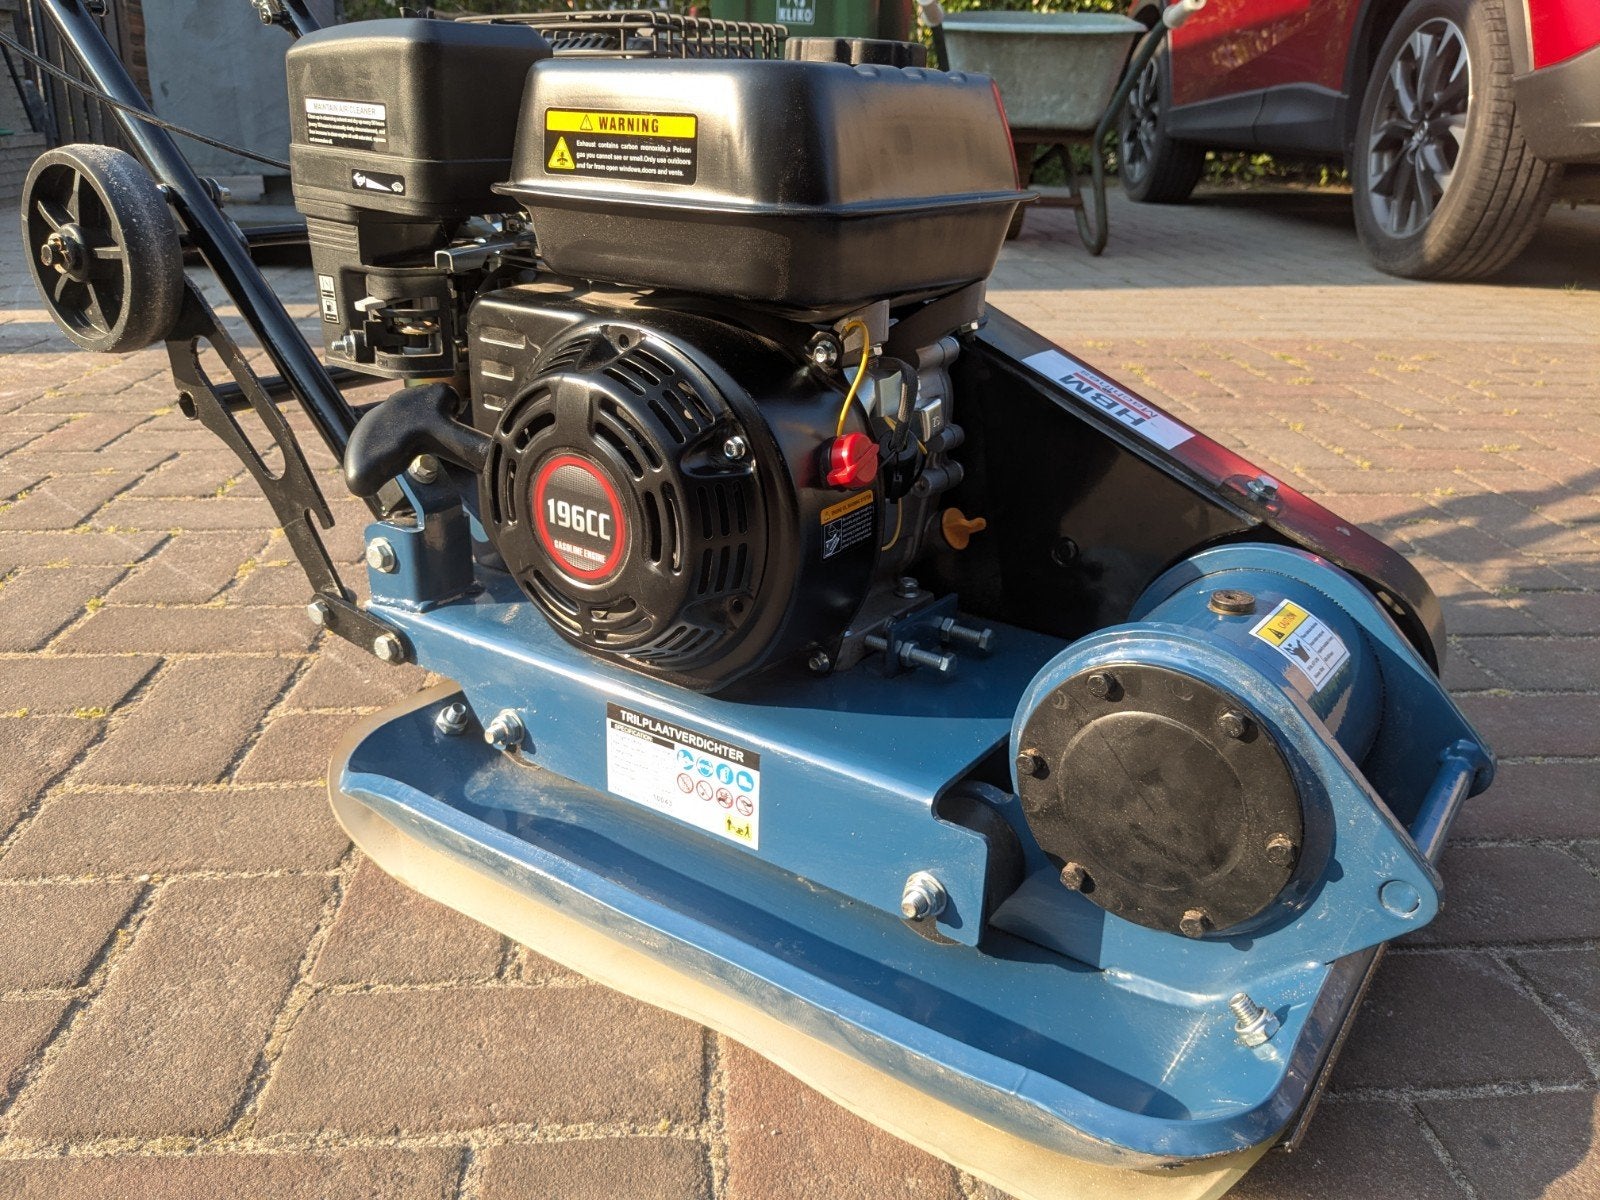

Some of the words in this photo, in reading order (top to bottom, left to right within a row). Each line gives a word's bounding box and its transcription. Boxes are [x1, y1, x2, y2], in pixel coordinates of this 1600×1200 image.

[779, 8, 813, 22] KLIKO
[598, 116, 659, 133] WARNING
[576, 140, 596, 148] Exhaust
[673, 145, 692, 154] Poison
[596, 152, 613, 160] cannot
[667, 156, 692, 166] outdoors
[606, 164, 619, 172] open
[1058, 374, 1146, 427] HBM
[547, 498, 611, 541] 196CC
[620, 709, 744, 763] TRILPLAATVERDICHTER
